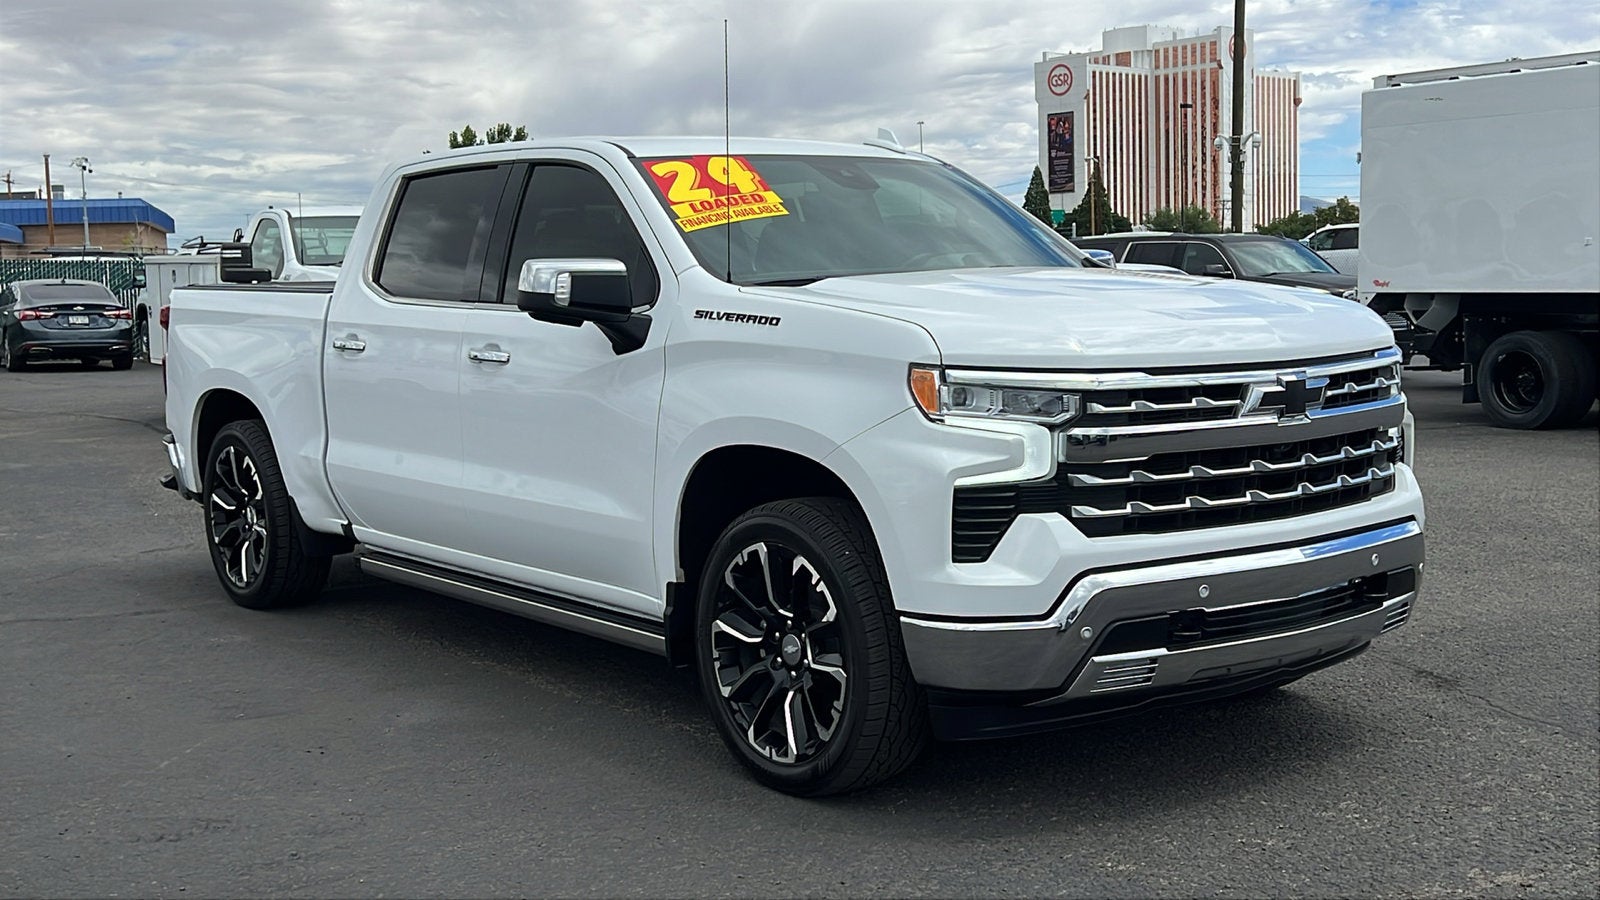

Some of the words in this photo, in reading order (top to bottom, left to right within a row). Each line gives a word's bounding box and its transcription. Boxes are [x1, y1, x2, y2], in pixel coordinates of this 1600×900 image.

[1051, 73, 1070, 87] GSR
[650, 156, 760, 203] 24
[688, 193, 766, 213] LOADED
[680, 211, 732, 229] FINANCING
[732, 204, 784, 218] AVAILABLE
[694, 309, 782, 327] SILVERADO
